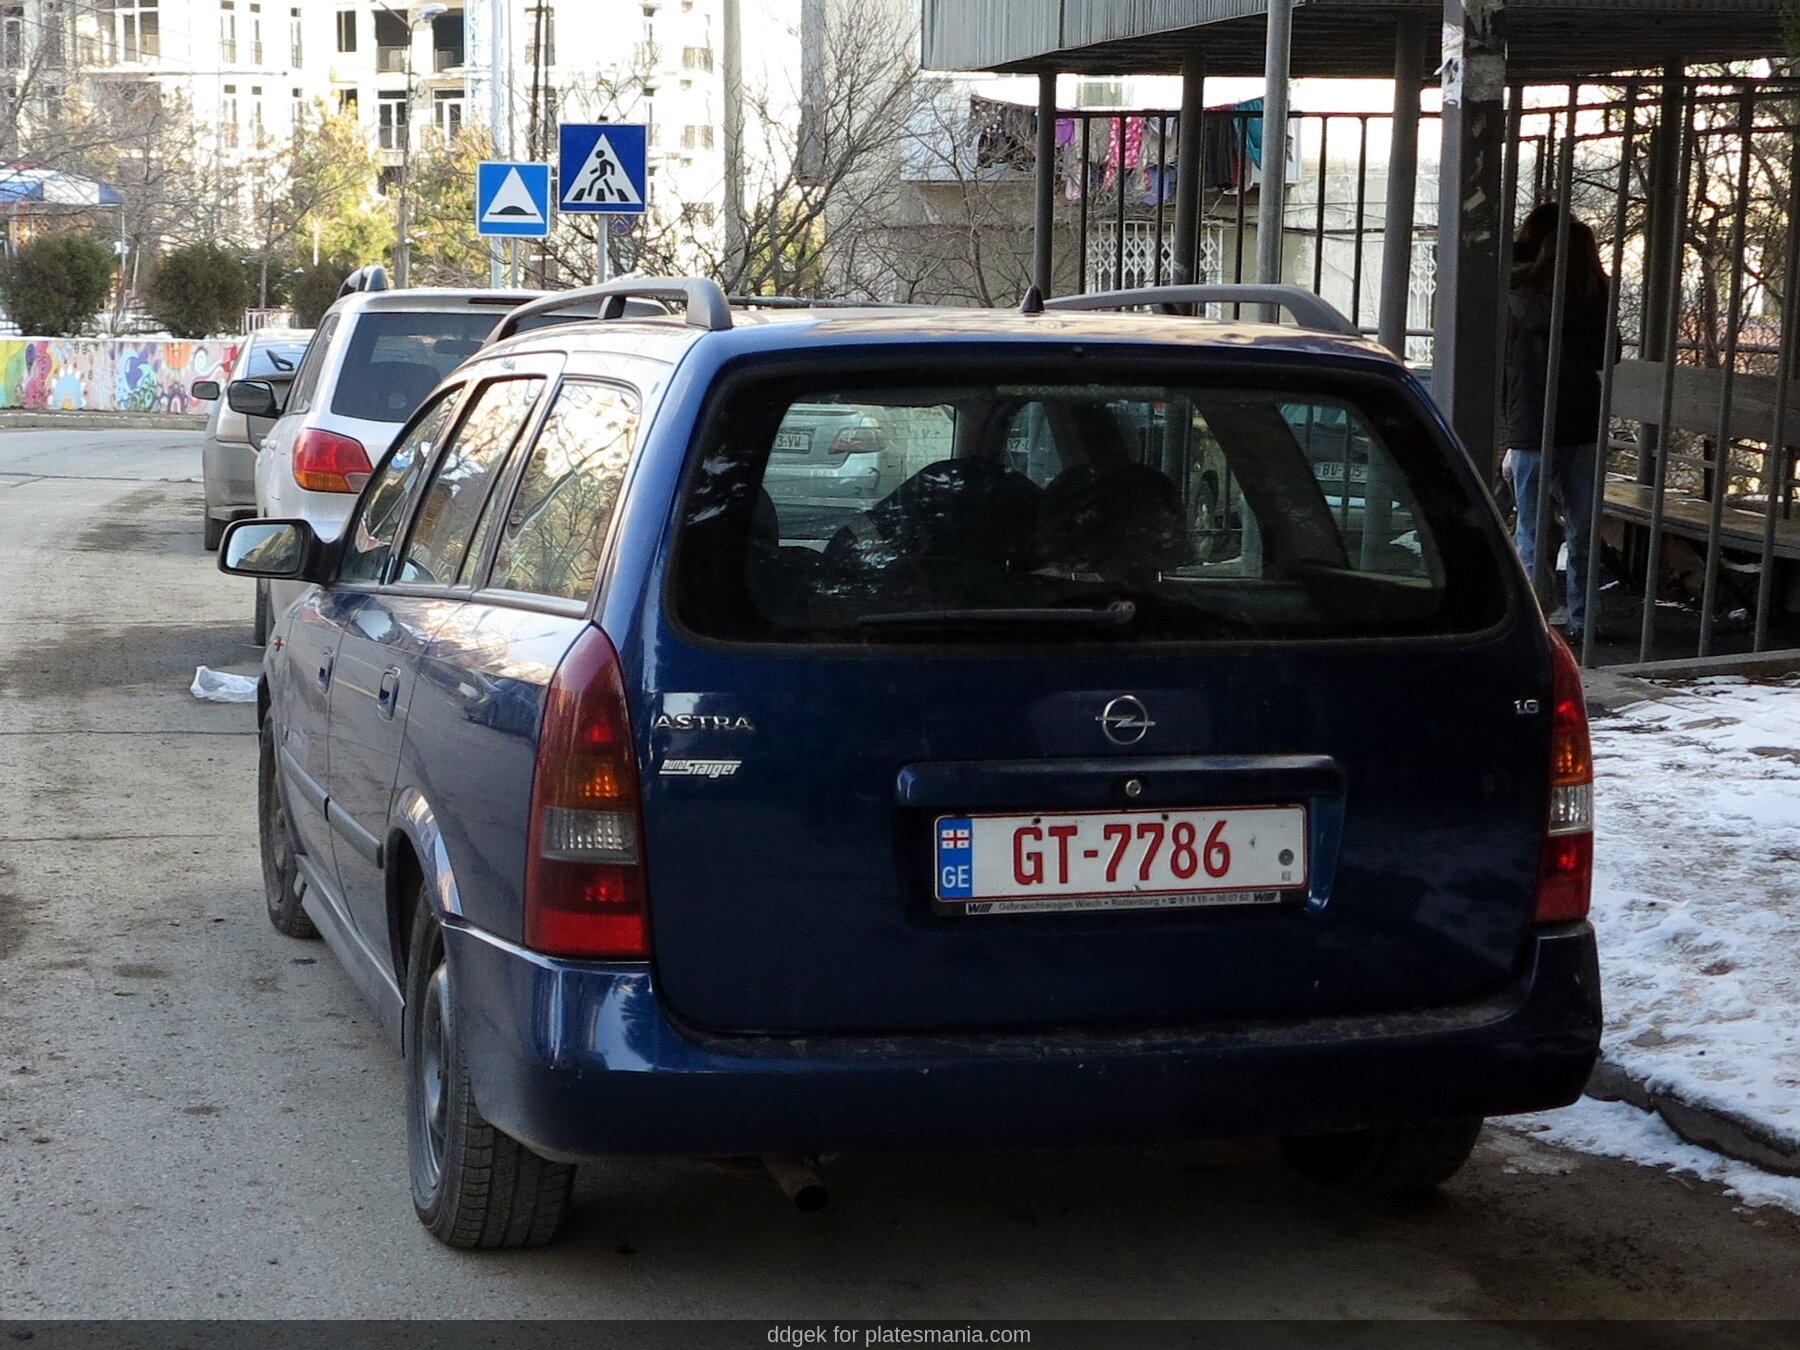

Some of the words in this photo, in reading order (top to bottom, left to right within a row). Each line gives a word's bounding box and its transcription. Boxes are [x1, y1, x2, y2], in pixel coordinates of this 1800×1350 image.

[654, 713, 755, 731] ASTRA
[1012, 819, 1232, 887] GT-7786
[941, 865, 970, 889] GE
